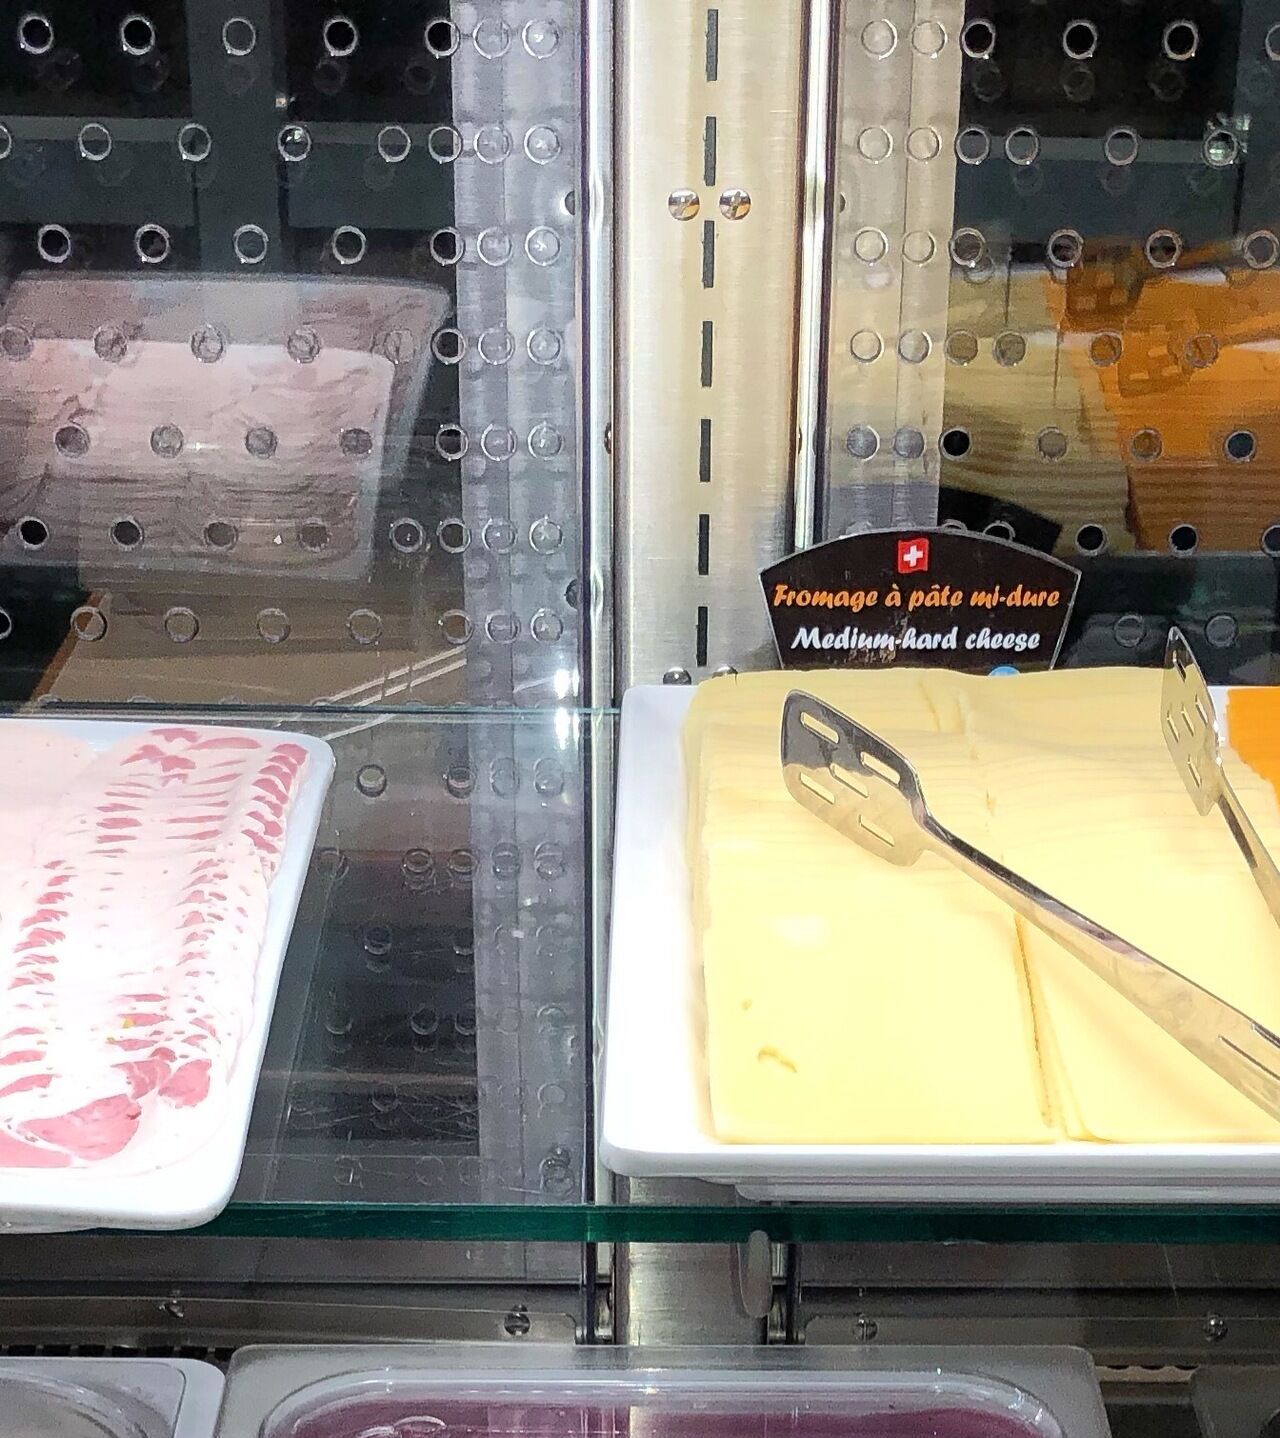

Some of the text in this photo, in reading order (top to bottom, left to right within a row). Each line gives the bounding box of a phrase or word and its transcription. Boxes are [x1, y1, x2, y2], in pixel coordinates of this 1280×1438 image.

[773, 583, 1061, 612] Fromage à pâte mi-dure
[790, 626, 1040, 652] Medium-hard cheese
